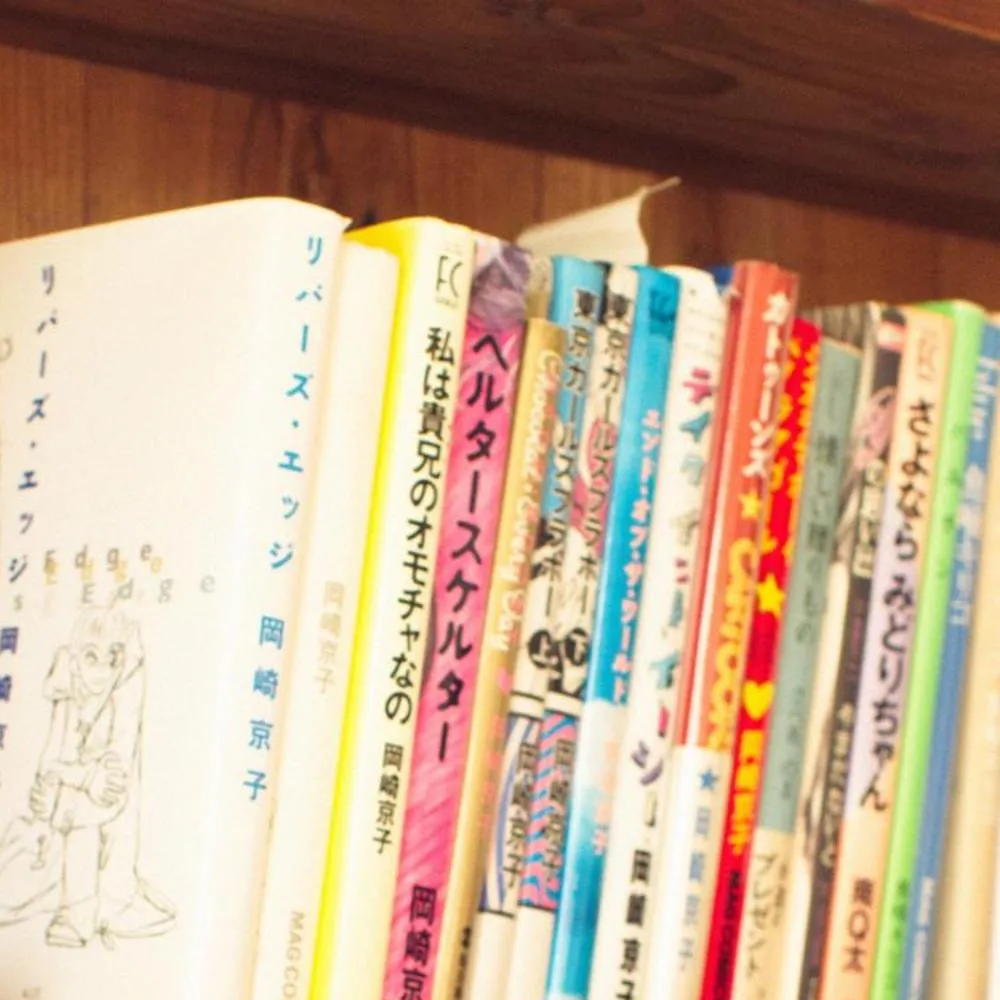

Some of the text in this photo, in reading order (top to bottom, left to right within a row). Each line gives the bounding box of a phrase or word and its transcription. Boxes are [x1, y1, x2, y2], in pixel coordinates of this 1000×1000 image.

[8, 265, 58, 584] リバーズ・エッジ
[268, 236, 324, 570] リバーズ・エッジ
[384, 326, 455, 726] 私は貴兄のオモチャなの
[437, 334, 511, 762] ヘルタースケルター
[242, 615, 286, 802] 岡崎京子
[860, 398, 934, 812] さよならみどりちゃん
[285, 910, 307, 962] MAG
[372, 742, 405, 855] 岡崎京子
